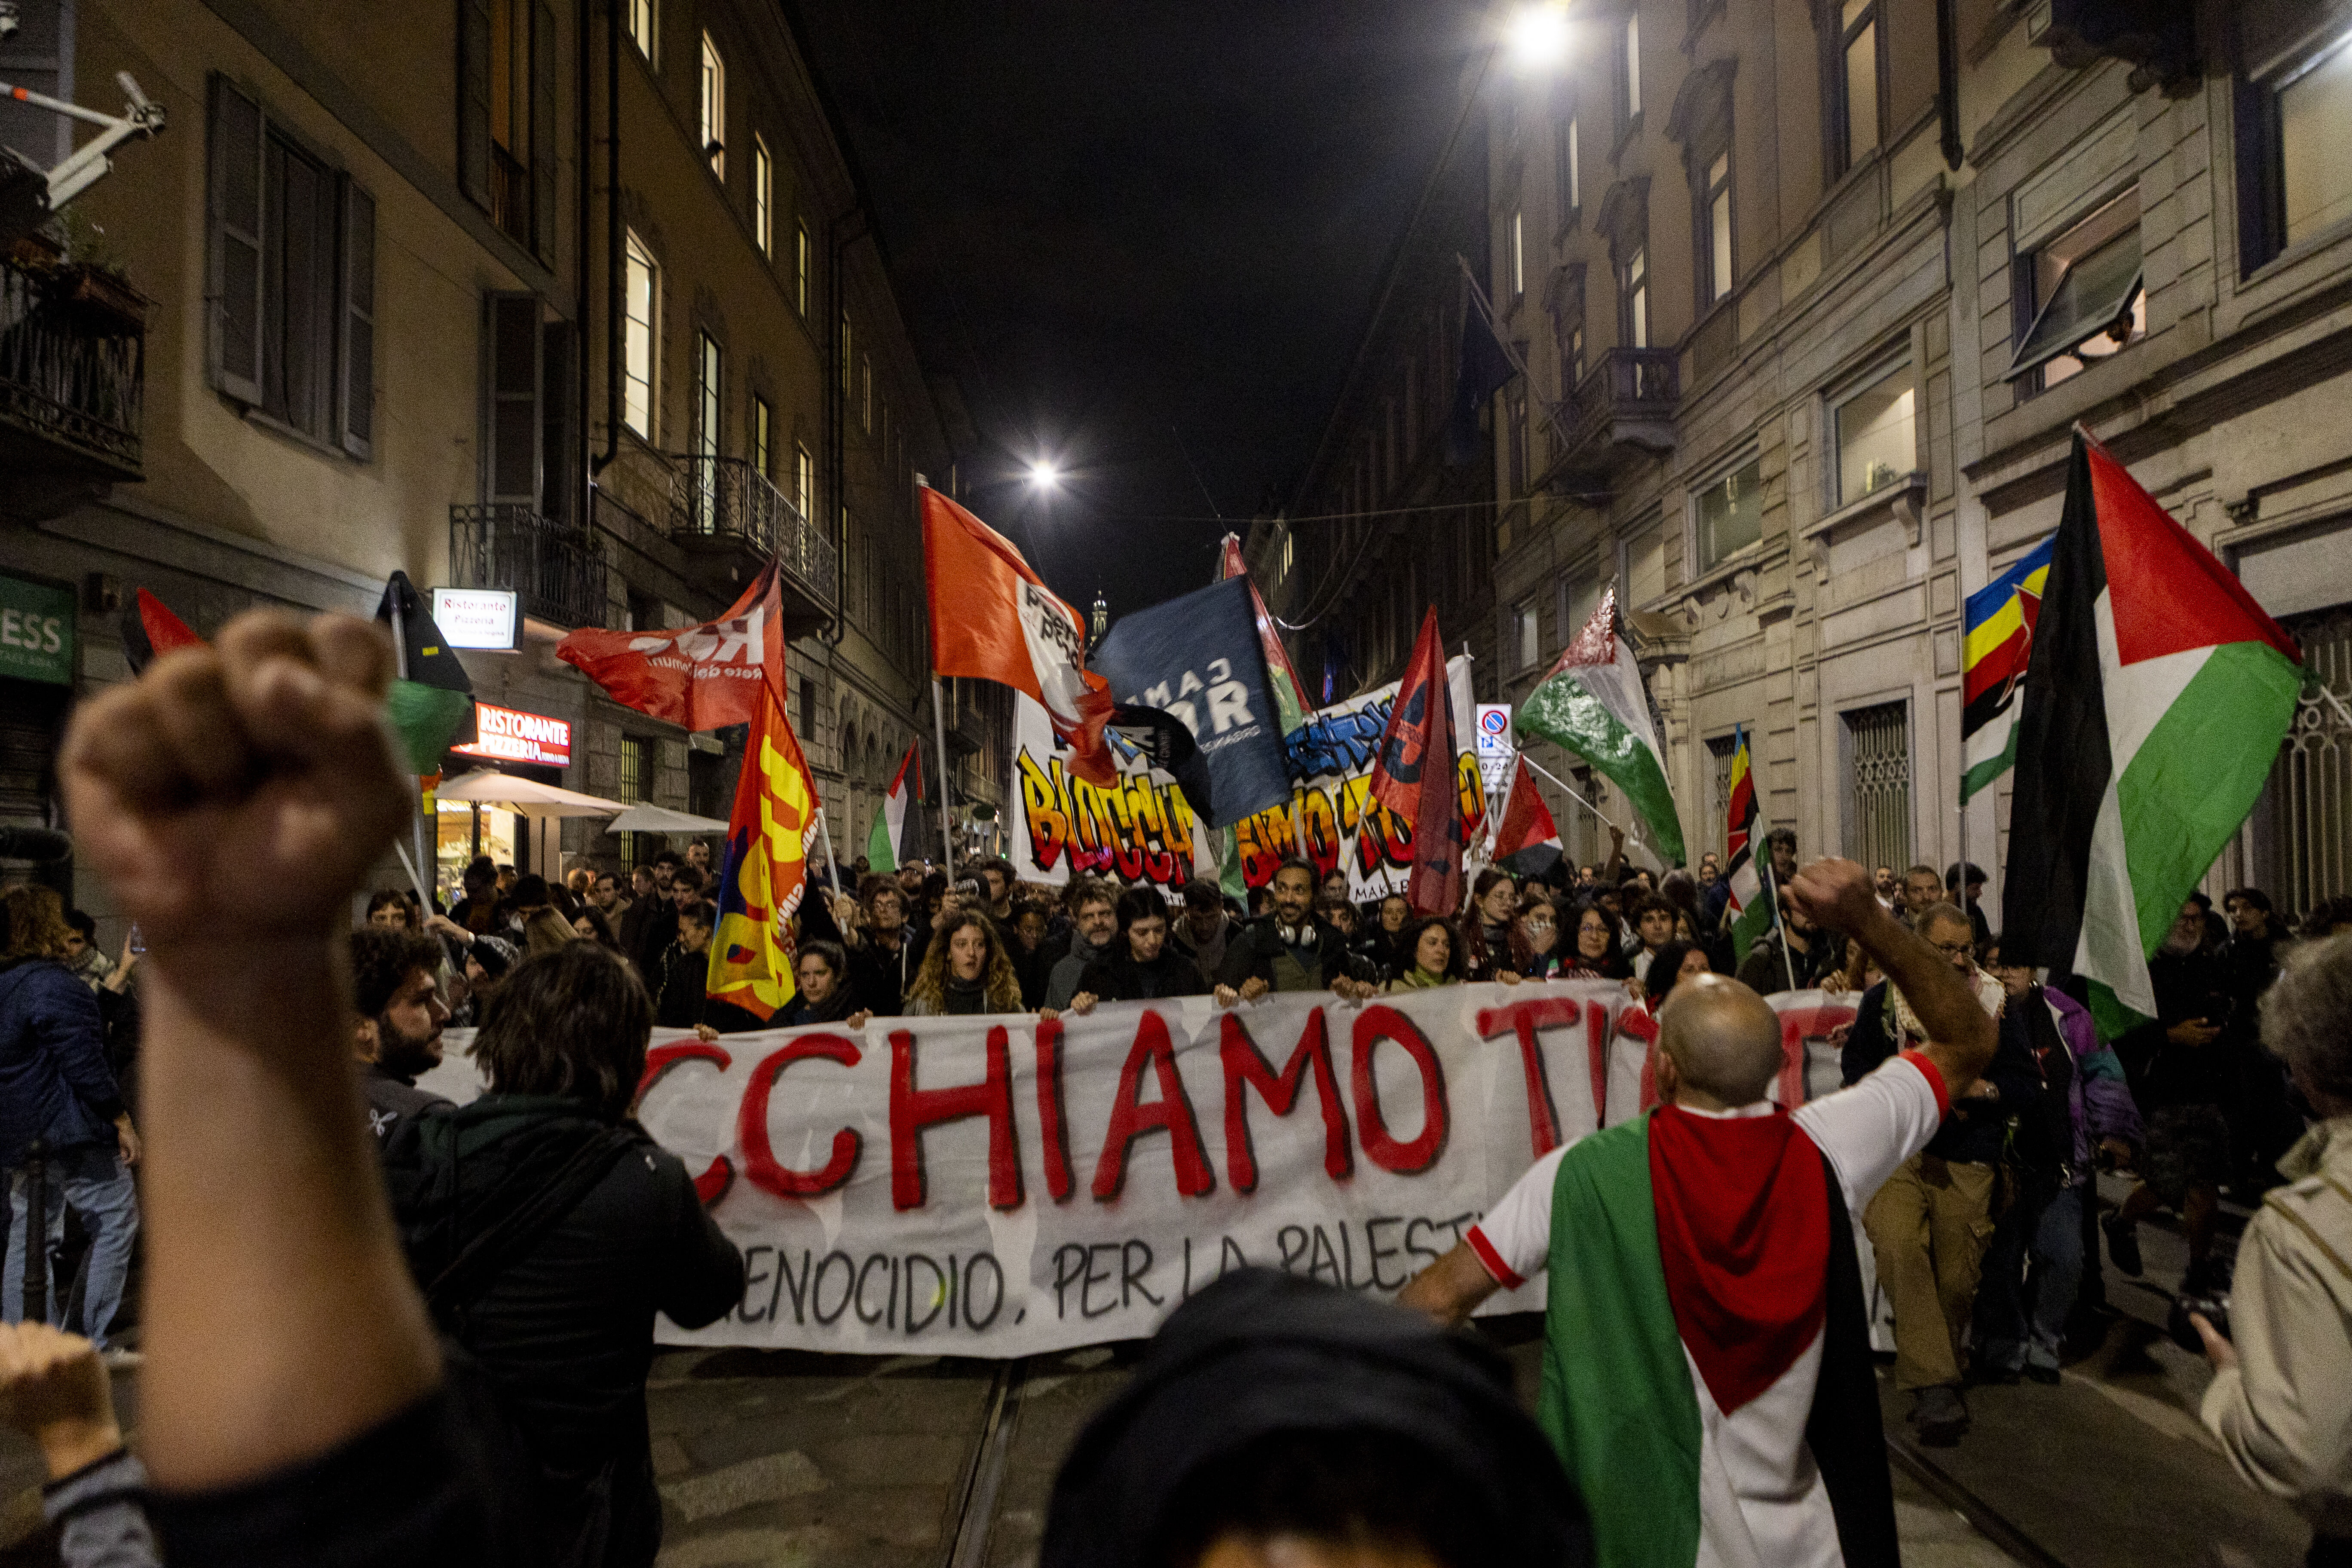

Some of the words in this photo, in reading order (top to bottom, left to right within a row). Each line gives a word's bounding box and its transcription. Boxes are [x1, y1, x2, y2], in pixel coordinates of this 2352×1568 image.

[445, 598, 506, 611] Ristorante
[454, 615, 494, 625] Pizzeria
[2, 608, 61, 653] ESS
[480, 706, 569, 746] RISTORANTE
[480, 732, 542, 761] PIZZERIA
[726, 1245, 1026, 1334] ENOCIDIO,
[1052, 1239, 1164, 1318] PER
[1277, 1210, 1484, 1291] PALEST
